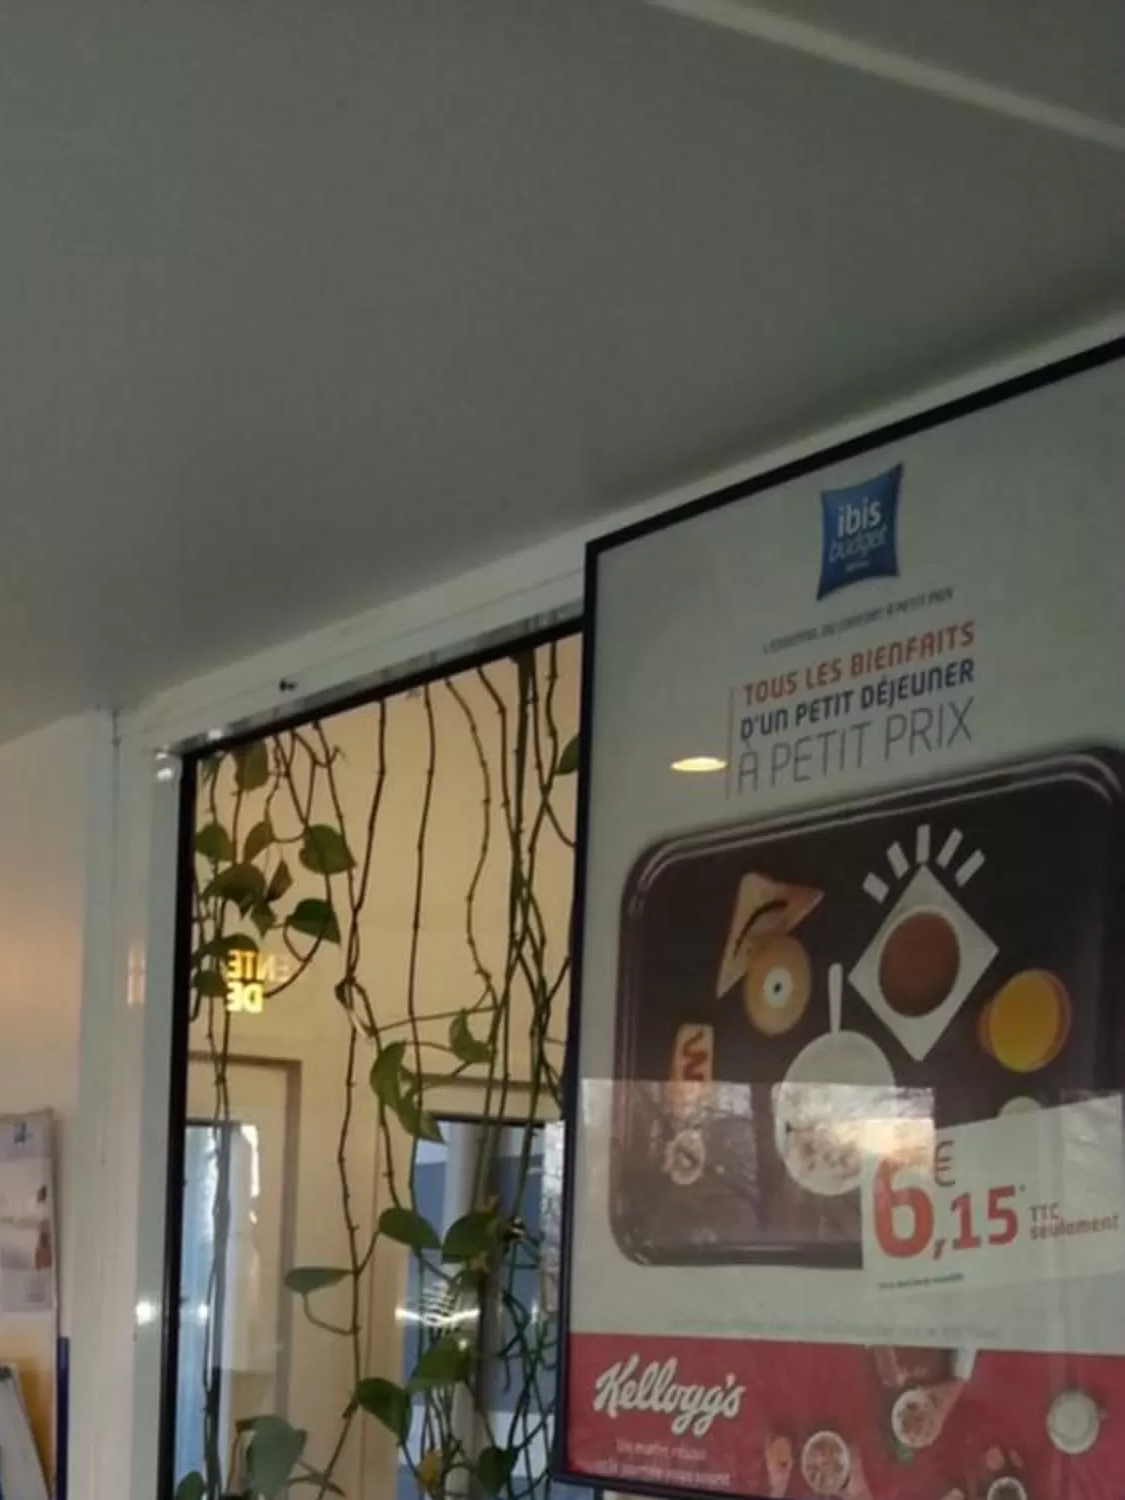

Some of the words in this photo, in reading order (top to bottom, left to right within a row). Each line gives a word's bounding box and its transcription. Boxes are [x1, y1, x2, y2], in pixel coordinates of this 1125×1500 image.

[837, 497, 882, 537] ibis
[740, 707, 789, 741] D'UN
[795, 689, 854, 728] PETIT
[861, 657, 975, 711] DÉJEUNER
[743, 671, 797, 707] TOUS
[805, 657, 842, 690] LES
[850, 620, 975, 678] BIENFAITS
[771, 721, 872, 788] PETIT
[884, 695, 974, 762] PRIX
[1029, 1212, 1120, 1241] seulement
[592, 1352, 746, 1437] Kellogg's
